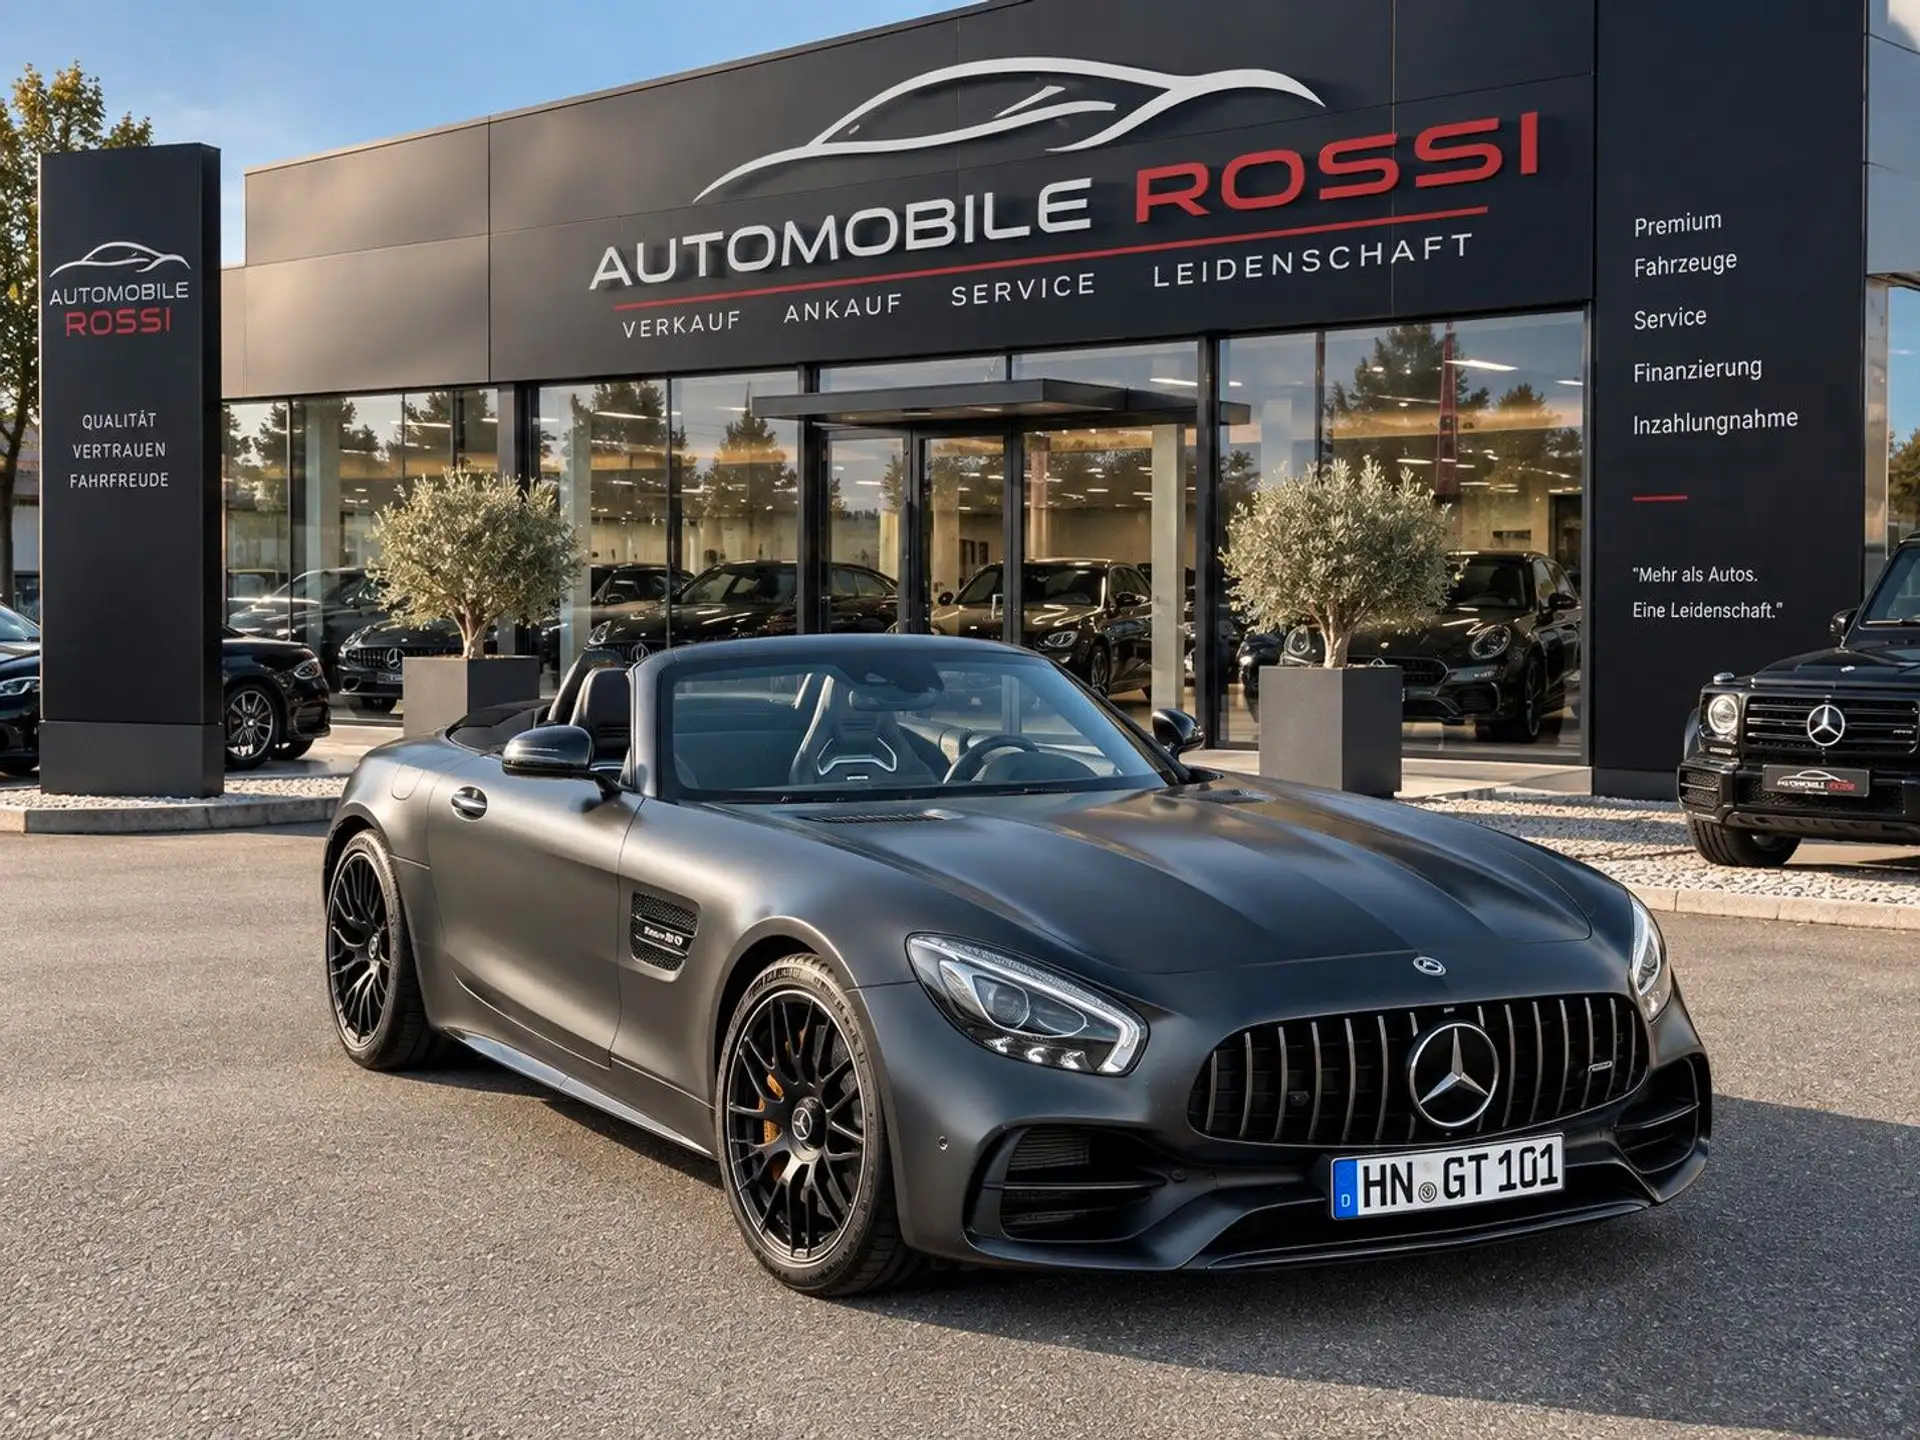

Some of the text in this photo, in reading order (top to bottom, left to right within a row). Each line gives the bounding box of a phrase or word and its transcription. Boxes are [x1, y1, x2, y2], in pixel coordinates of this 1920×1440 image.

[589, 112, 1538, 291] AUTOMOBILE ROSSI
[1635, 212, 1722, 238] Premium
[1635, 252, 1738, 278] Fahrzeuge
[49, 281, 189, 306] AUTOMOBILE
[622, 232, 1473, 339] VERKAUF ANKAUF SERVICE LEIDENSCHAFT
[65, 308, 170, 336] ROSSI
[1634, 307, 1707, 330] Service
[1634, 357, 1762, 382] Finanzierung
[1634, 408, 1799, 436] Inzahlungnahme
[72, 443, 166, 460] VERTRAUEN
[69, 472, 169, 489] FAHRFREUDE
[1681, 565, 1703, 583] als
[1708, 566, 1758, 583] Autos.
[1633, 602, 1666, 618] Eine
[1363, 1143, 1558, 1208] HN GT 101
[1341, 1194, 1351, 1208] D
